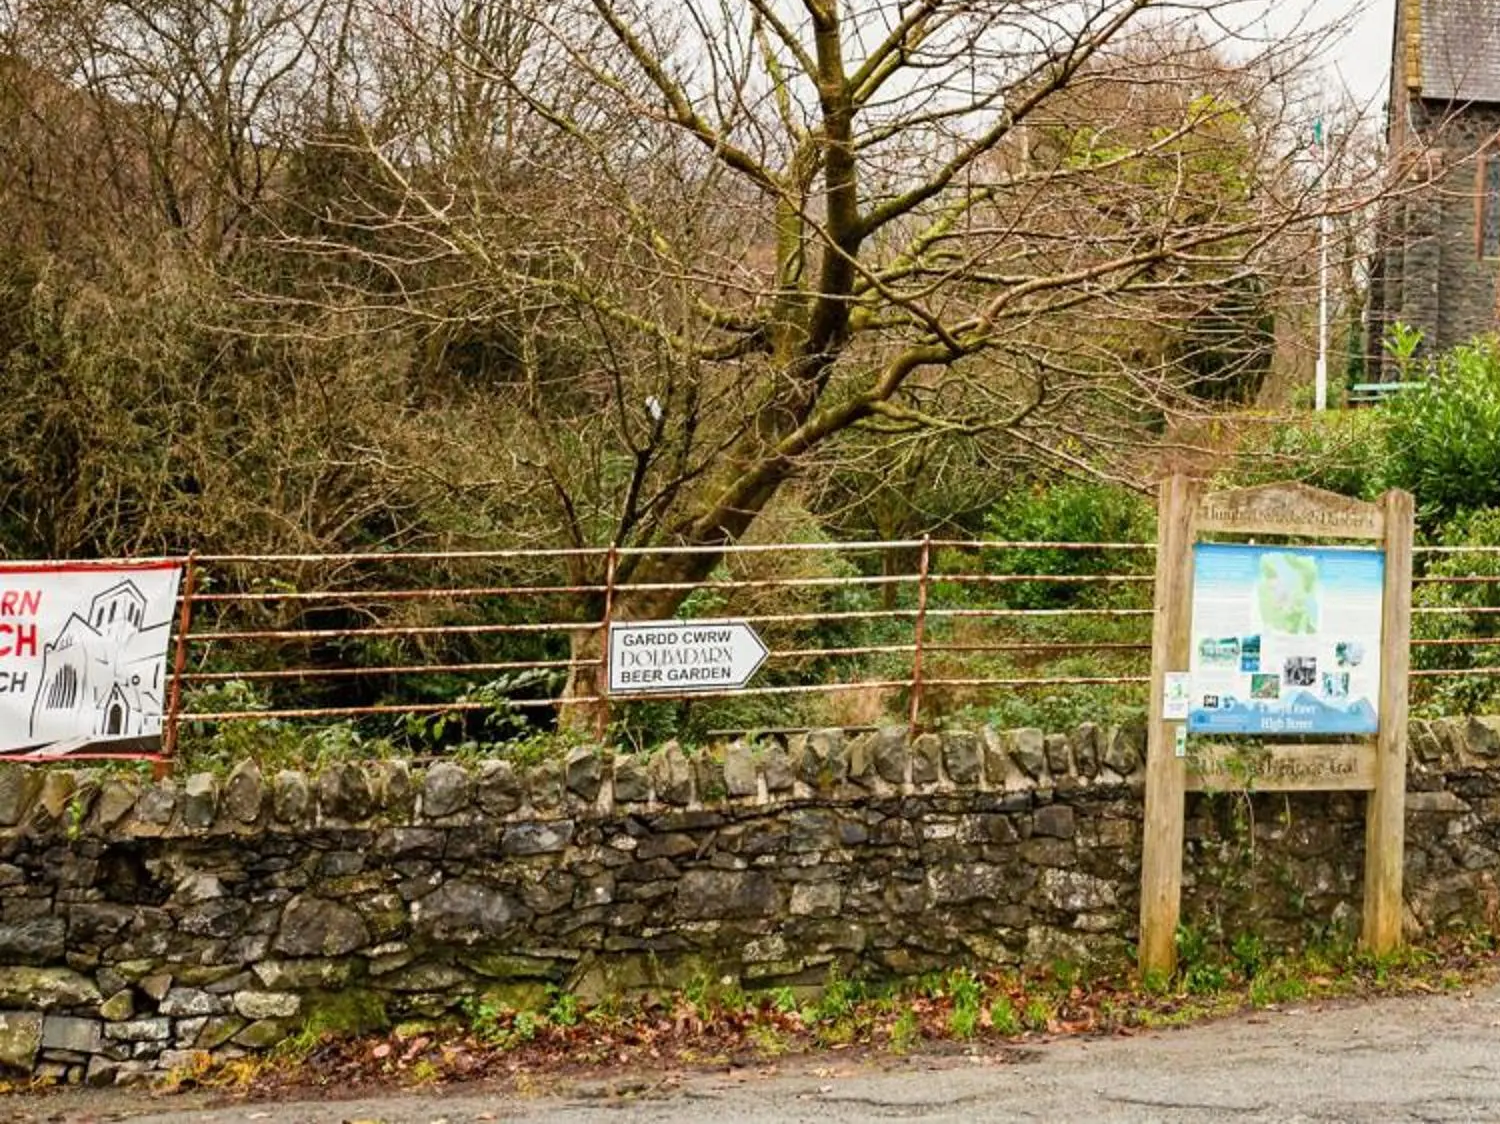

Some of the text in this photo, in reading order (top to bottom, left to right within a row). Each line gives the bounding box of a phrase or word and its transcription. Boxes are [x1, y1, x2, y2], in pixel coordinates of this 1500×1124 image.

[623, 631, 731, 646] GARDD CWRW
[621, 667, 731, 683] BEER GARDEN
